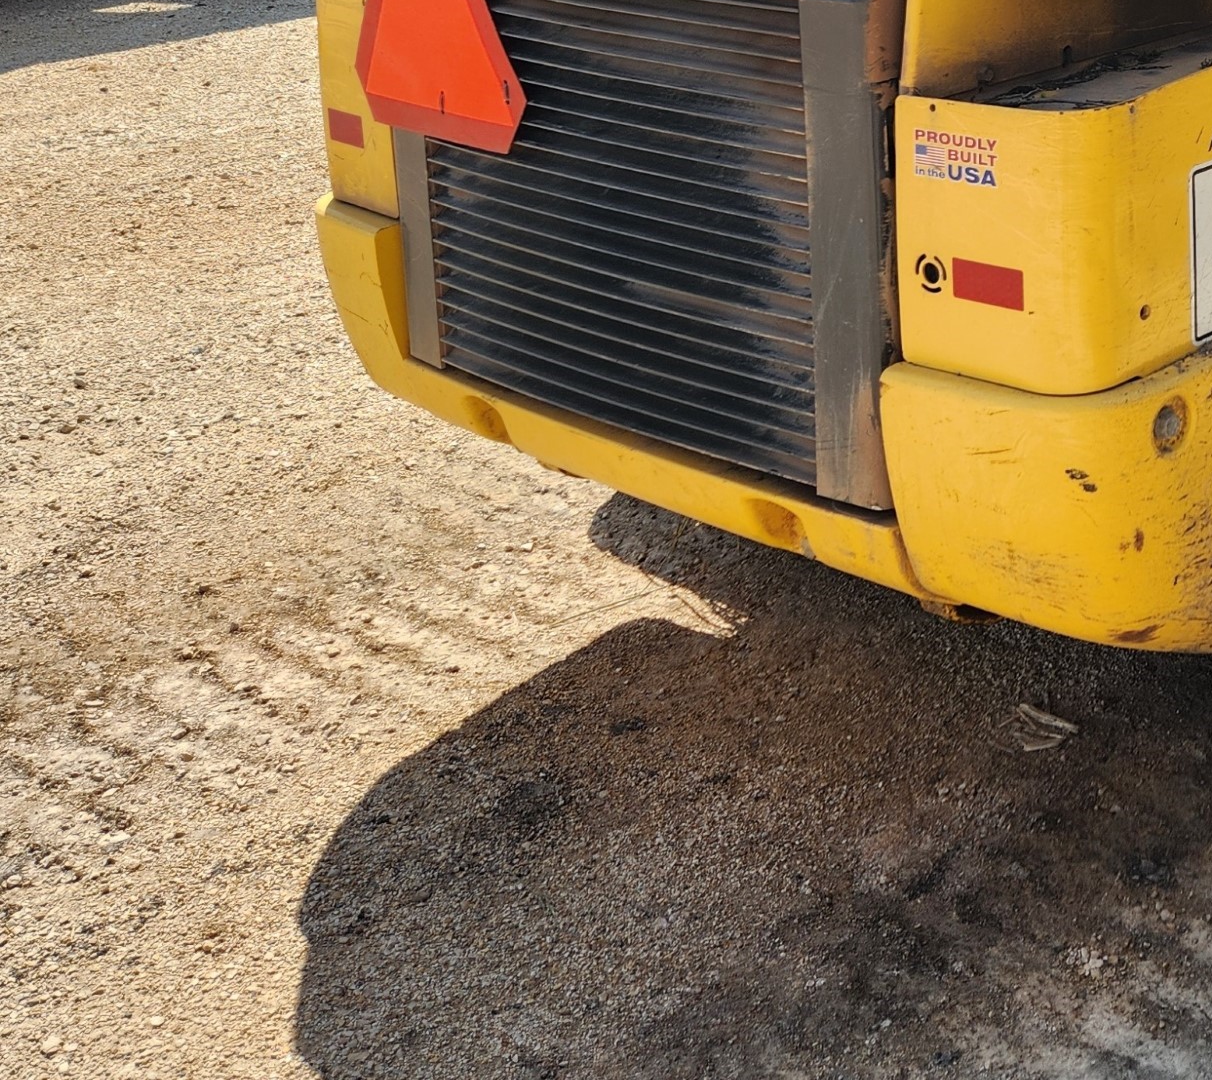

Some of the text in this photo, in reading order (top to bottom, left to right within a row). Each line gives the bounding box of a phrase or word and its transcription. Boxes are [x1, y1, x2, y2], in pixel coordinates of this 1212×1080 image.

[915, 129, 997, 152] PROUDLY
[947, 149, 997, 167] BUILT
[915, 164, 997, 187] in the USA
